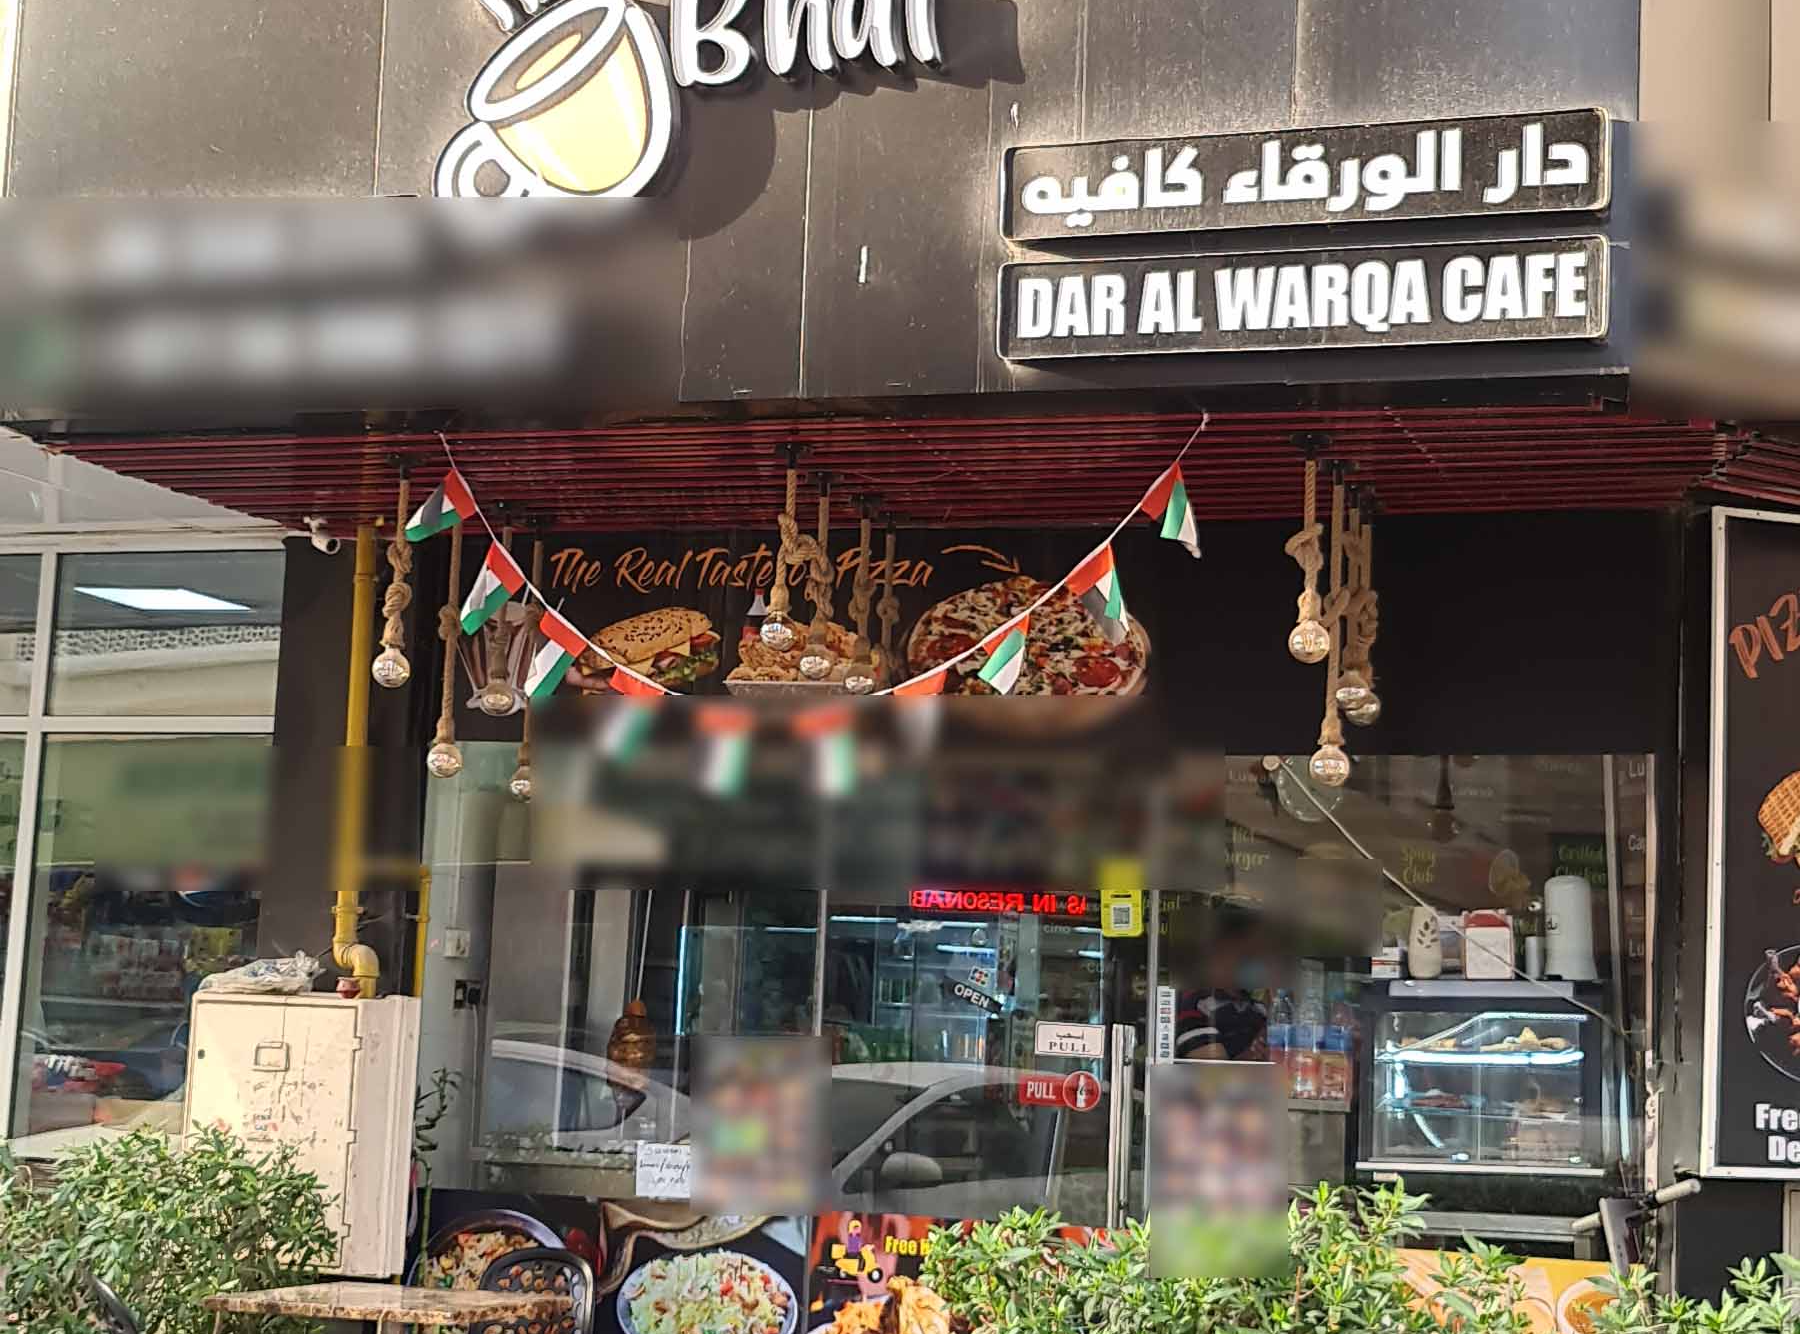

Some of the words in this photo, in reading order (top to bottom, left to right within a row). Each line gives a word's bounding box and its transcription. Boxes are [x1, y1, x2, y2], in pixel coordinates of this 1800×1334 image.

[1222, 126, 1462, 213] الورقاء
[1482, 122, 1589, 204] دار
[1022, 145, 1202, 227] كافيه
[1016, 272, 1126, 338] DAR
[1137, 270, 1203, 334] AL
[1214, 258, 1432, 334] WARQA
[1442, 251, 1588, 324] CAFE
[550, 547, 601, 594] The
[614, 546, 693, 594] Real
[696, 543, 774, 591] Taste
[836, 547, 934, 589] Pzza
[954, 983, 990, 1008] OPEN
[1049, 1041, 1091, 1054] PULL
[1026, 1081, 1057, 1099] PULL
[1755, 1103, 1800, 1131] Fre
[885, 1235, 918, 1256] Free
